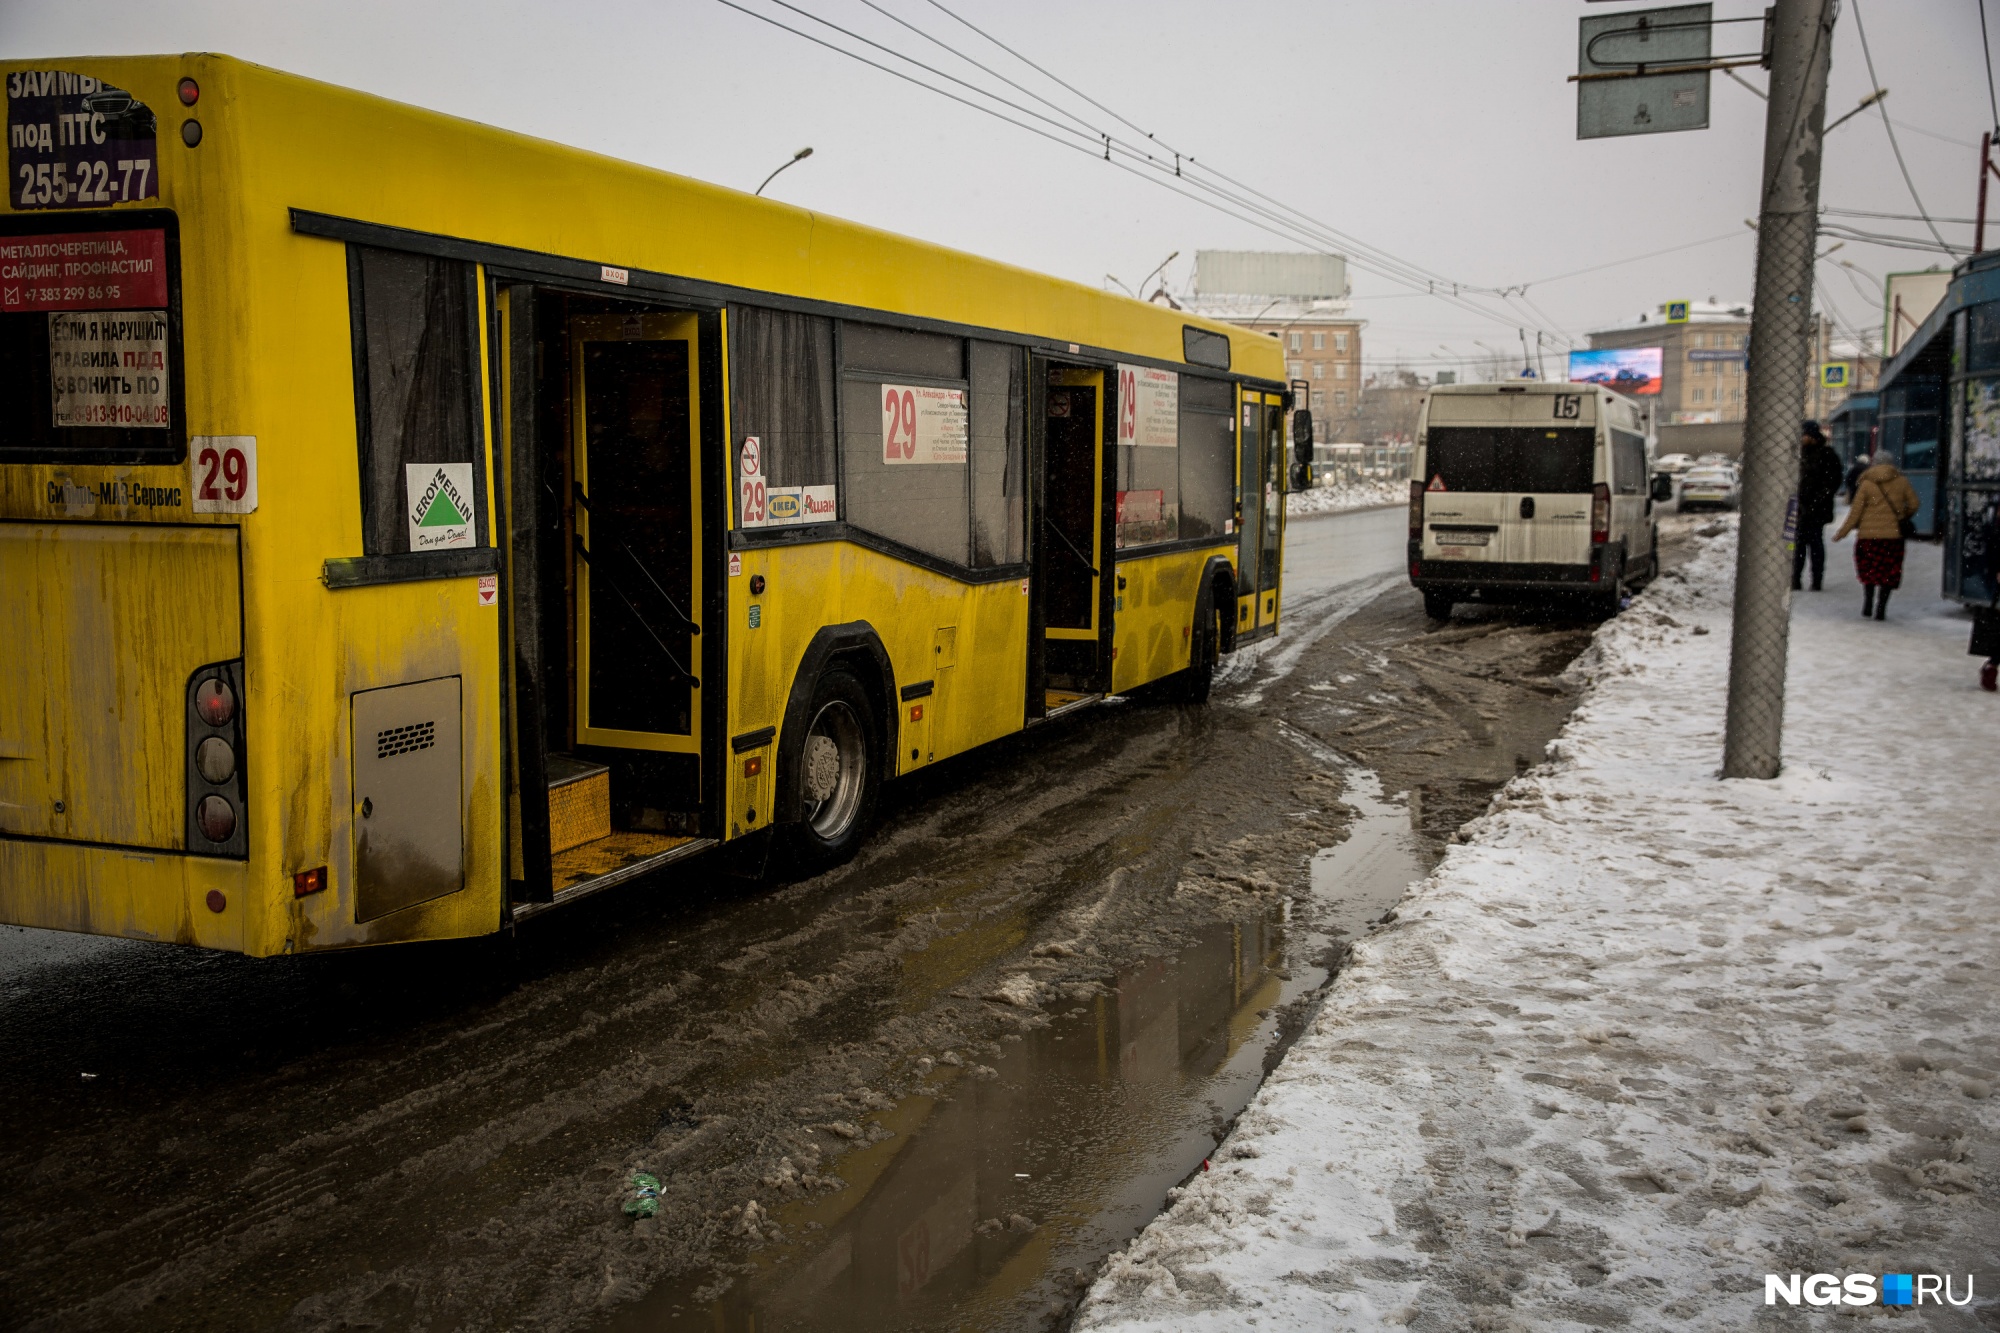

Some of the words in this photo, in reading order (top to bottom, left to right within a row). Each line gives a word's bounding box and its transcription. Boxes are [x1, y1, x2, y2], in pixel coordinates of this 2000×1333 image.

[12, 123, 53, 153] под
[59, 112, 106, 146] ПТС
[20, 159, 151, 204] 255-22-77
[1, 240, 128, 259] МЕТАЛЛОЧЕРЕПИЦА,
[2, 262, 62, 280] САЙДИНГ,
[65, 258, 153, 277] ПРОФНАСТИЛ
[605, 269, 624, 281] ВХОД
[24, 289, 37, 301] +7
[40, 287, 61, 301] 383
[64, 287, 85, 300] 299
[88, 286, 103, 299] 86
[106, 285, 120, 299] 95
[54, 322, 86, 341] ЕСЛИ
[90, 322, 98, 341] Я
[102, 322, 163, 341] НАРУШИЛ
[54, 352, 120, 369] ПРАВИЛА
[123, 351, 164, 371] ПДД
[55, 376, 132, 395] ЗВОНИТЬ
[137, 376, 160, 395] ПО
[1119, 369, 1135, 439] 29
[1556, 394, 1579, 419] 15
[885, 389, 917, 460] 29
[199, 447, 248, 501] 29
[411, 477, 440, 526] LEROY
[435, 467, 473, 523] MERLIN
[742, 481, 766, 522] 29
[773, 501, 797, 512] IKEA
